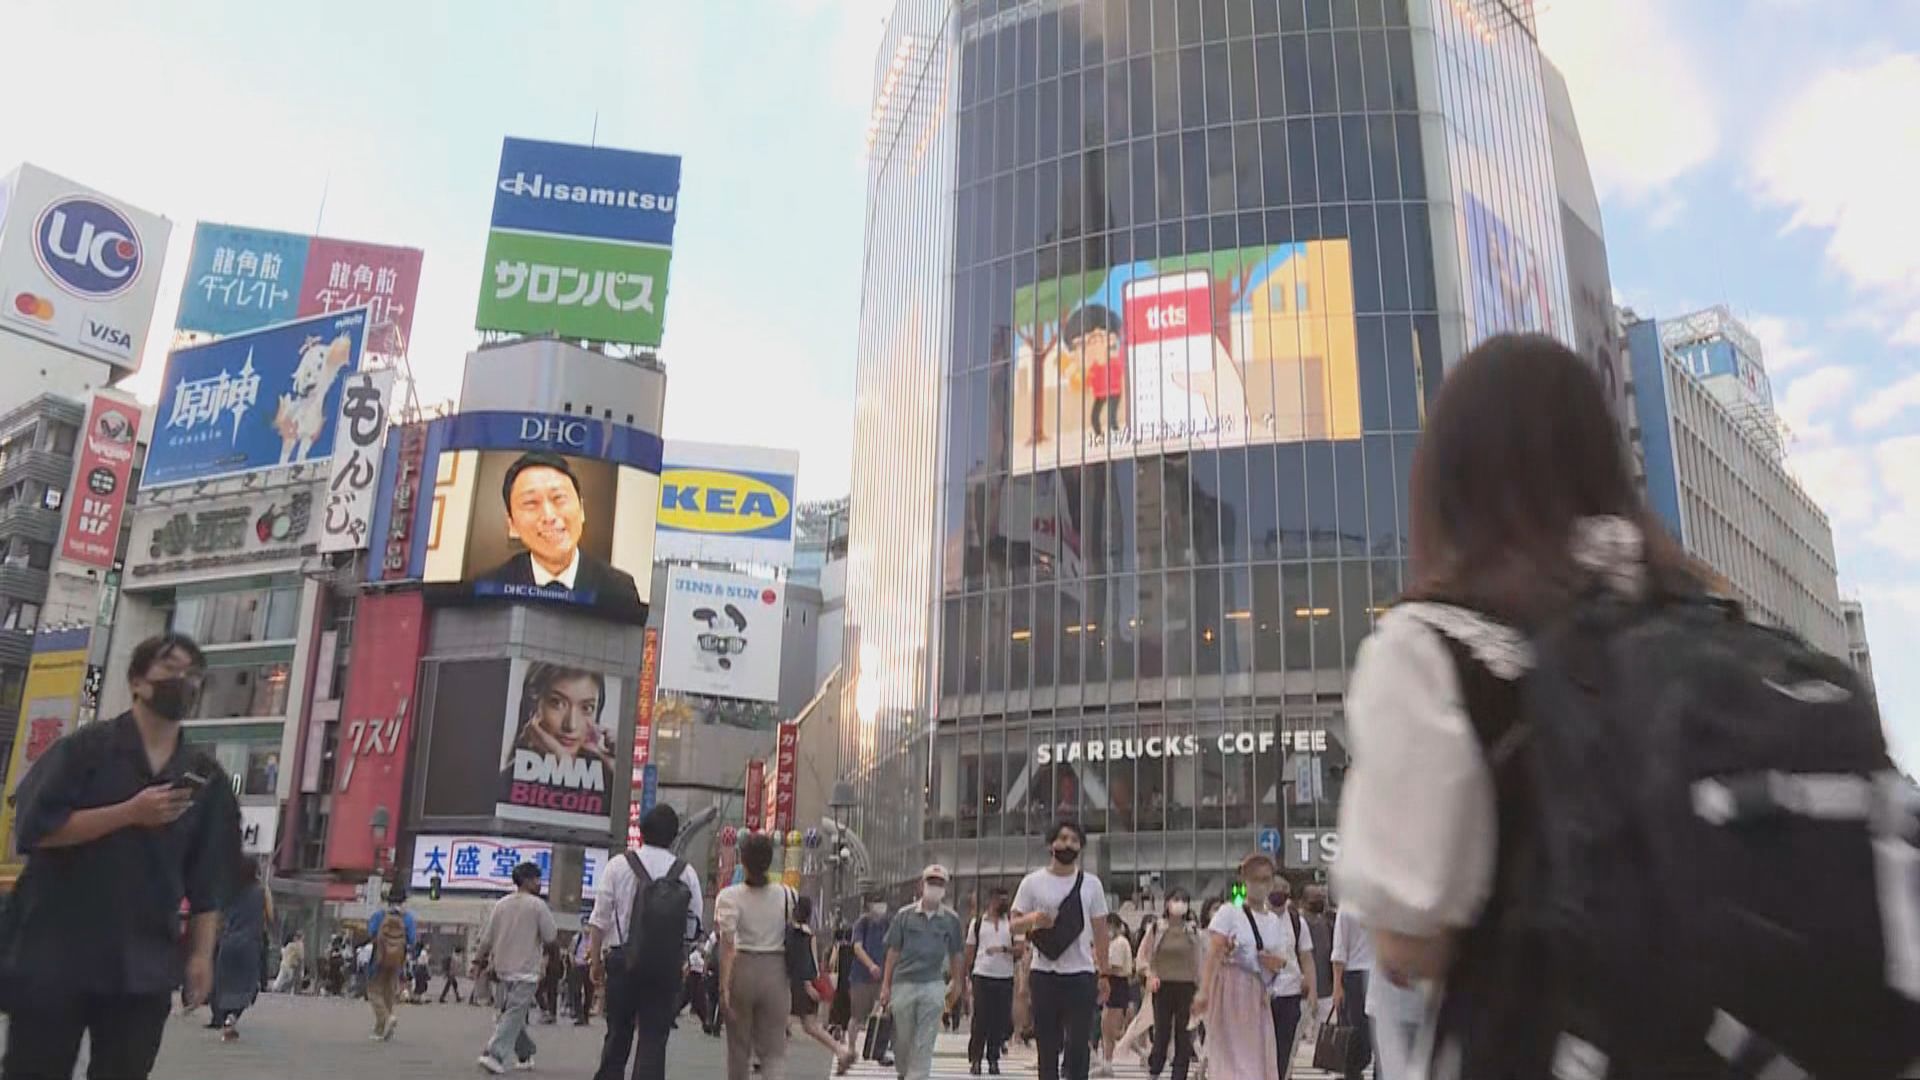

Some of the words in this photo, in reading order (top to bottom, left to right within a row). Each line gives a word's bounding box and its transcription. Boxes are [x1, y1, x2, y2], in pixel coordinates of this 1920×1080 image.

[500, 172, 674, 211] Hisamitsu
[48, 211, 134, 278] UC
[212, 246, 283, 280] 龍角散
[197, 275, 289, 309] ダイレクト
[495, 260, 653, 314] サロンパス
[1147, 304, 1188, 329] tkts
[89, 322, 132, 349] VISA
[165, 345, 261, 447] 原神
[520, 417, 587, 446] DHC
[325, 373, 384, 545] もんじゃ
[504, 584, 528, 595] DHC
[727, 586, 759, 600] SUN
[340, 697, 408, 793] クスリ
[1037, 735, 1199, 764] STARBUCKS
[1218, 730, 1326, 753] COFFEE
[513, 748, 604, 791] DMM
[510, 781, 601, 812] Bitcoin
